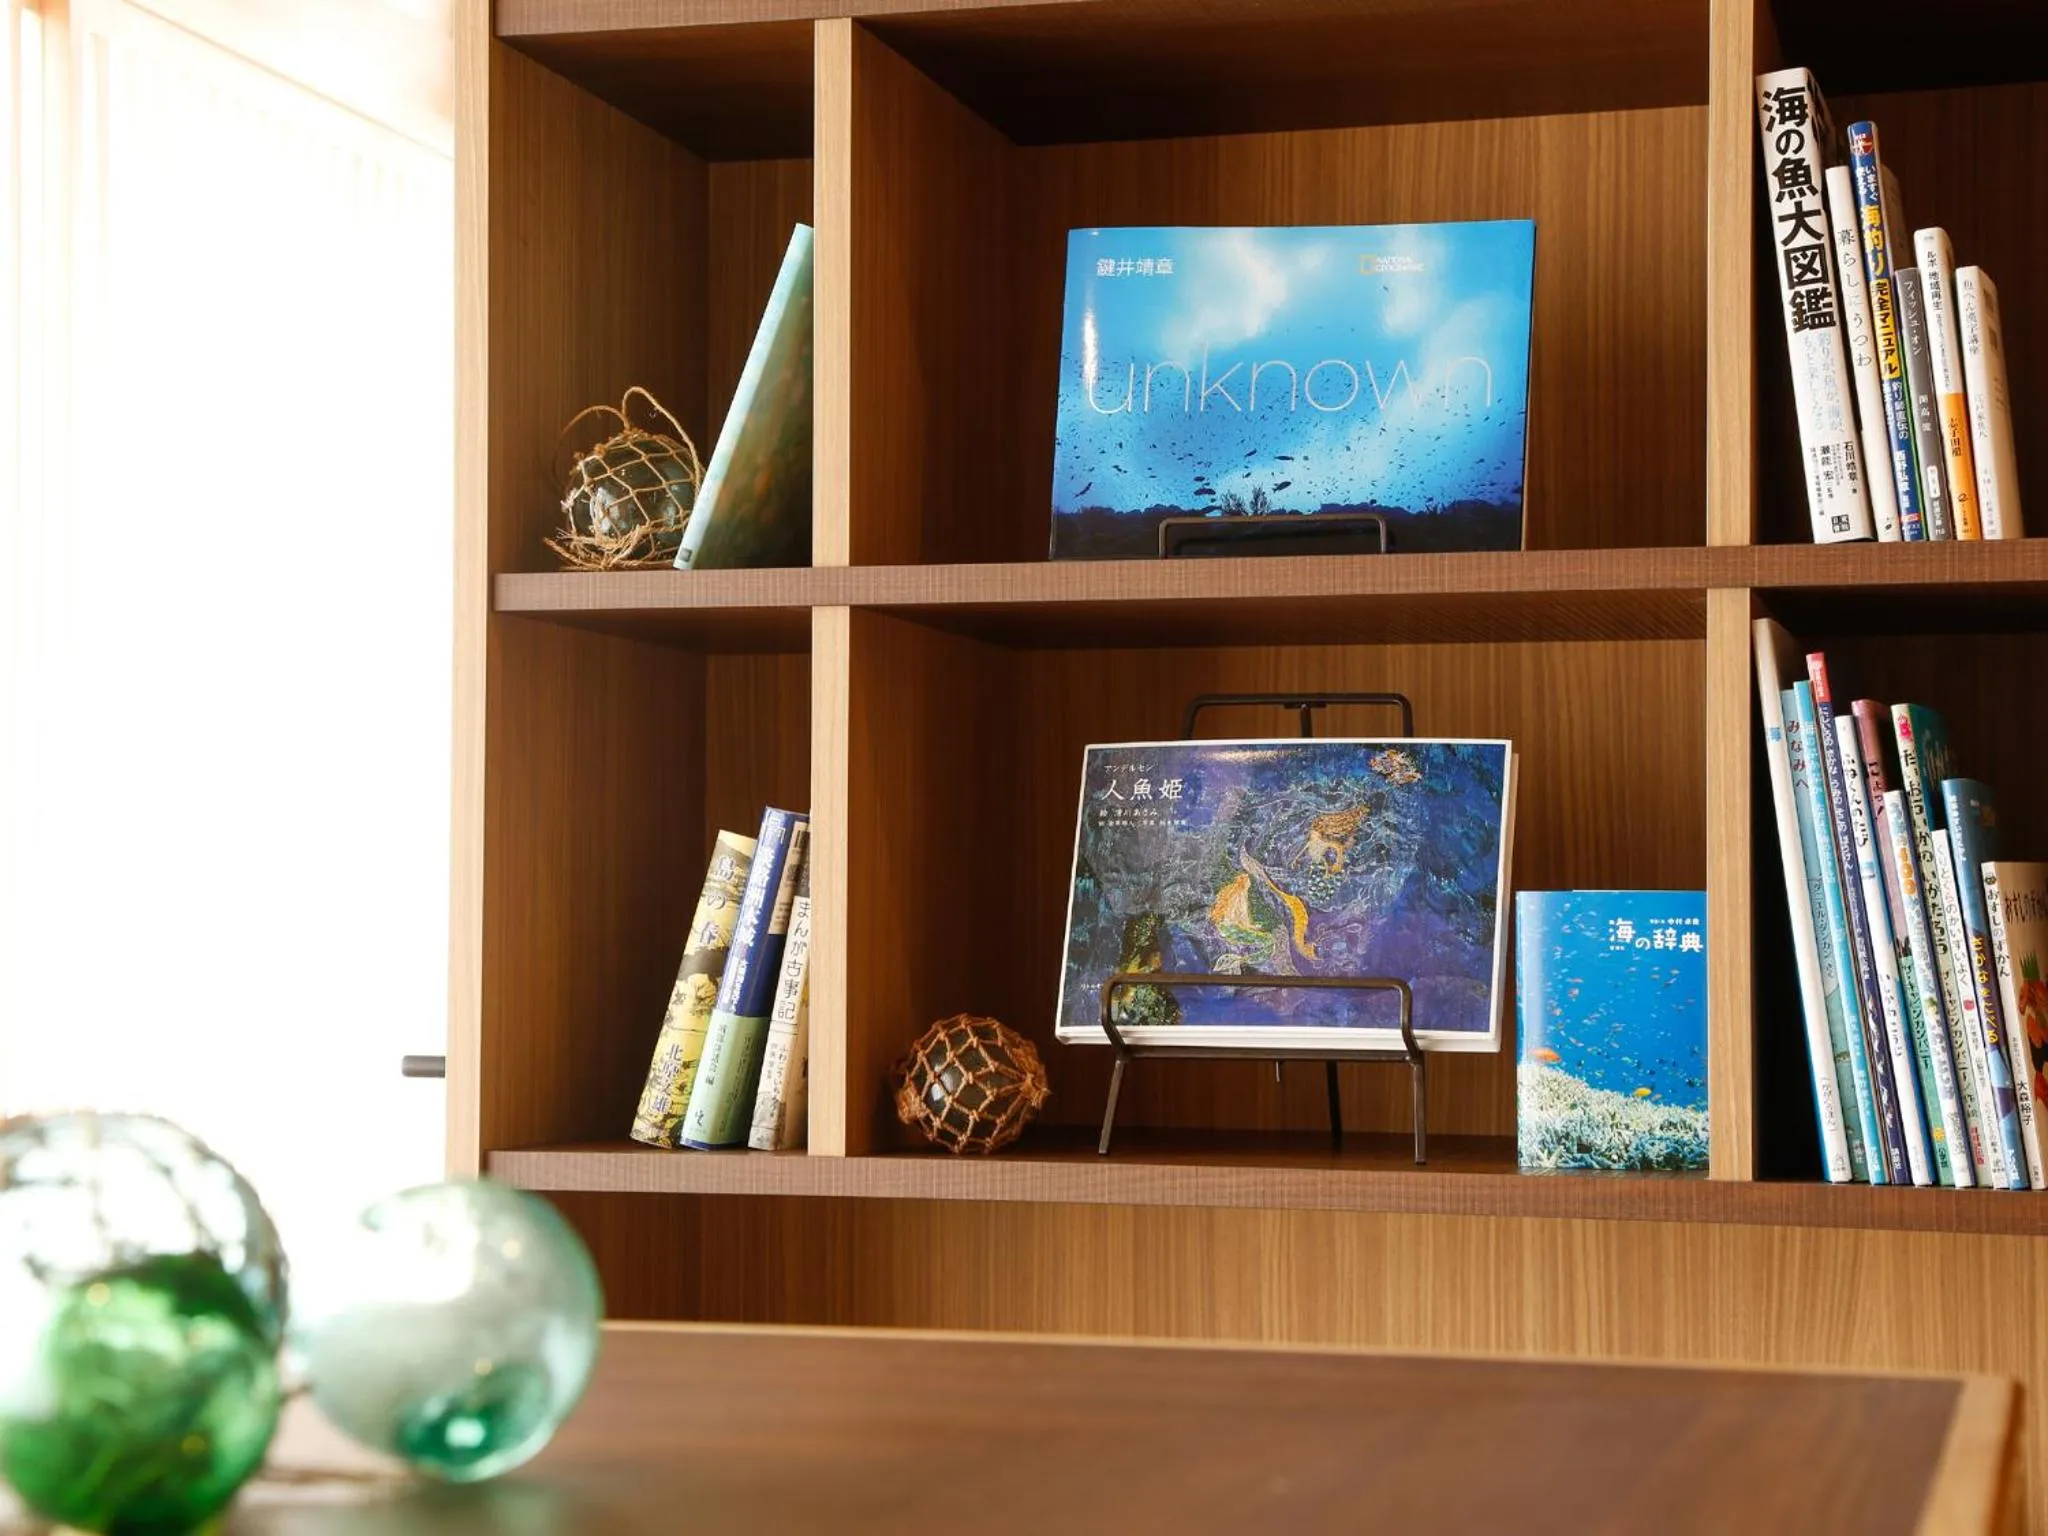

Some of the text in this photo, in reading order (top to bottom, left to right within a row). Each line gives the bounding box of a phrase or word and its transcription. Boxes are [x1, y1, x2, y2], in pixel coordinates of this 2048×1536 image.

[1762, 86, 1837, 333] 海の魚大図鑑
[1086, 344, 1492, 414] unknown
[1103, 764, 1155, 774] アンデルセン
[1787, 720, 1809, 788] みなみへ
[1101, 777, 1184, 801] 人魚姫
[777, 900, 810, 1020] まんが古事記
[1608, 917, 1704, 953] 海の辞典
[1987, 889, 2011, 978] おすしのずかん
